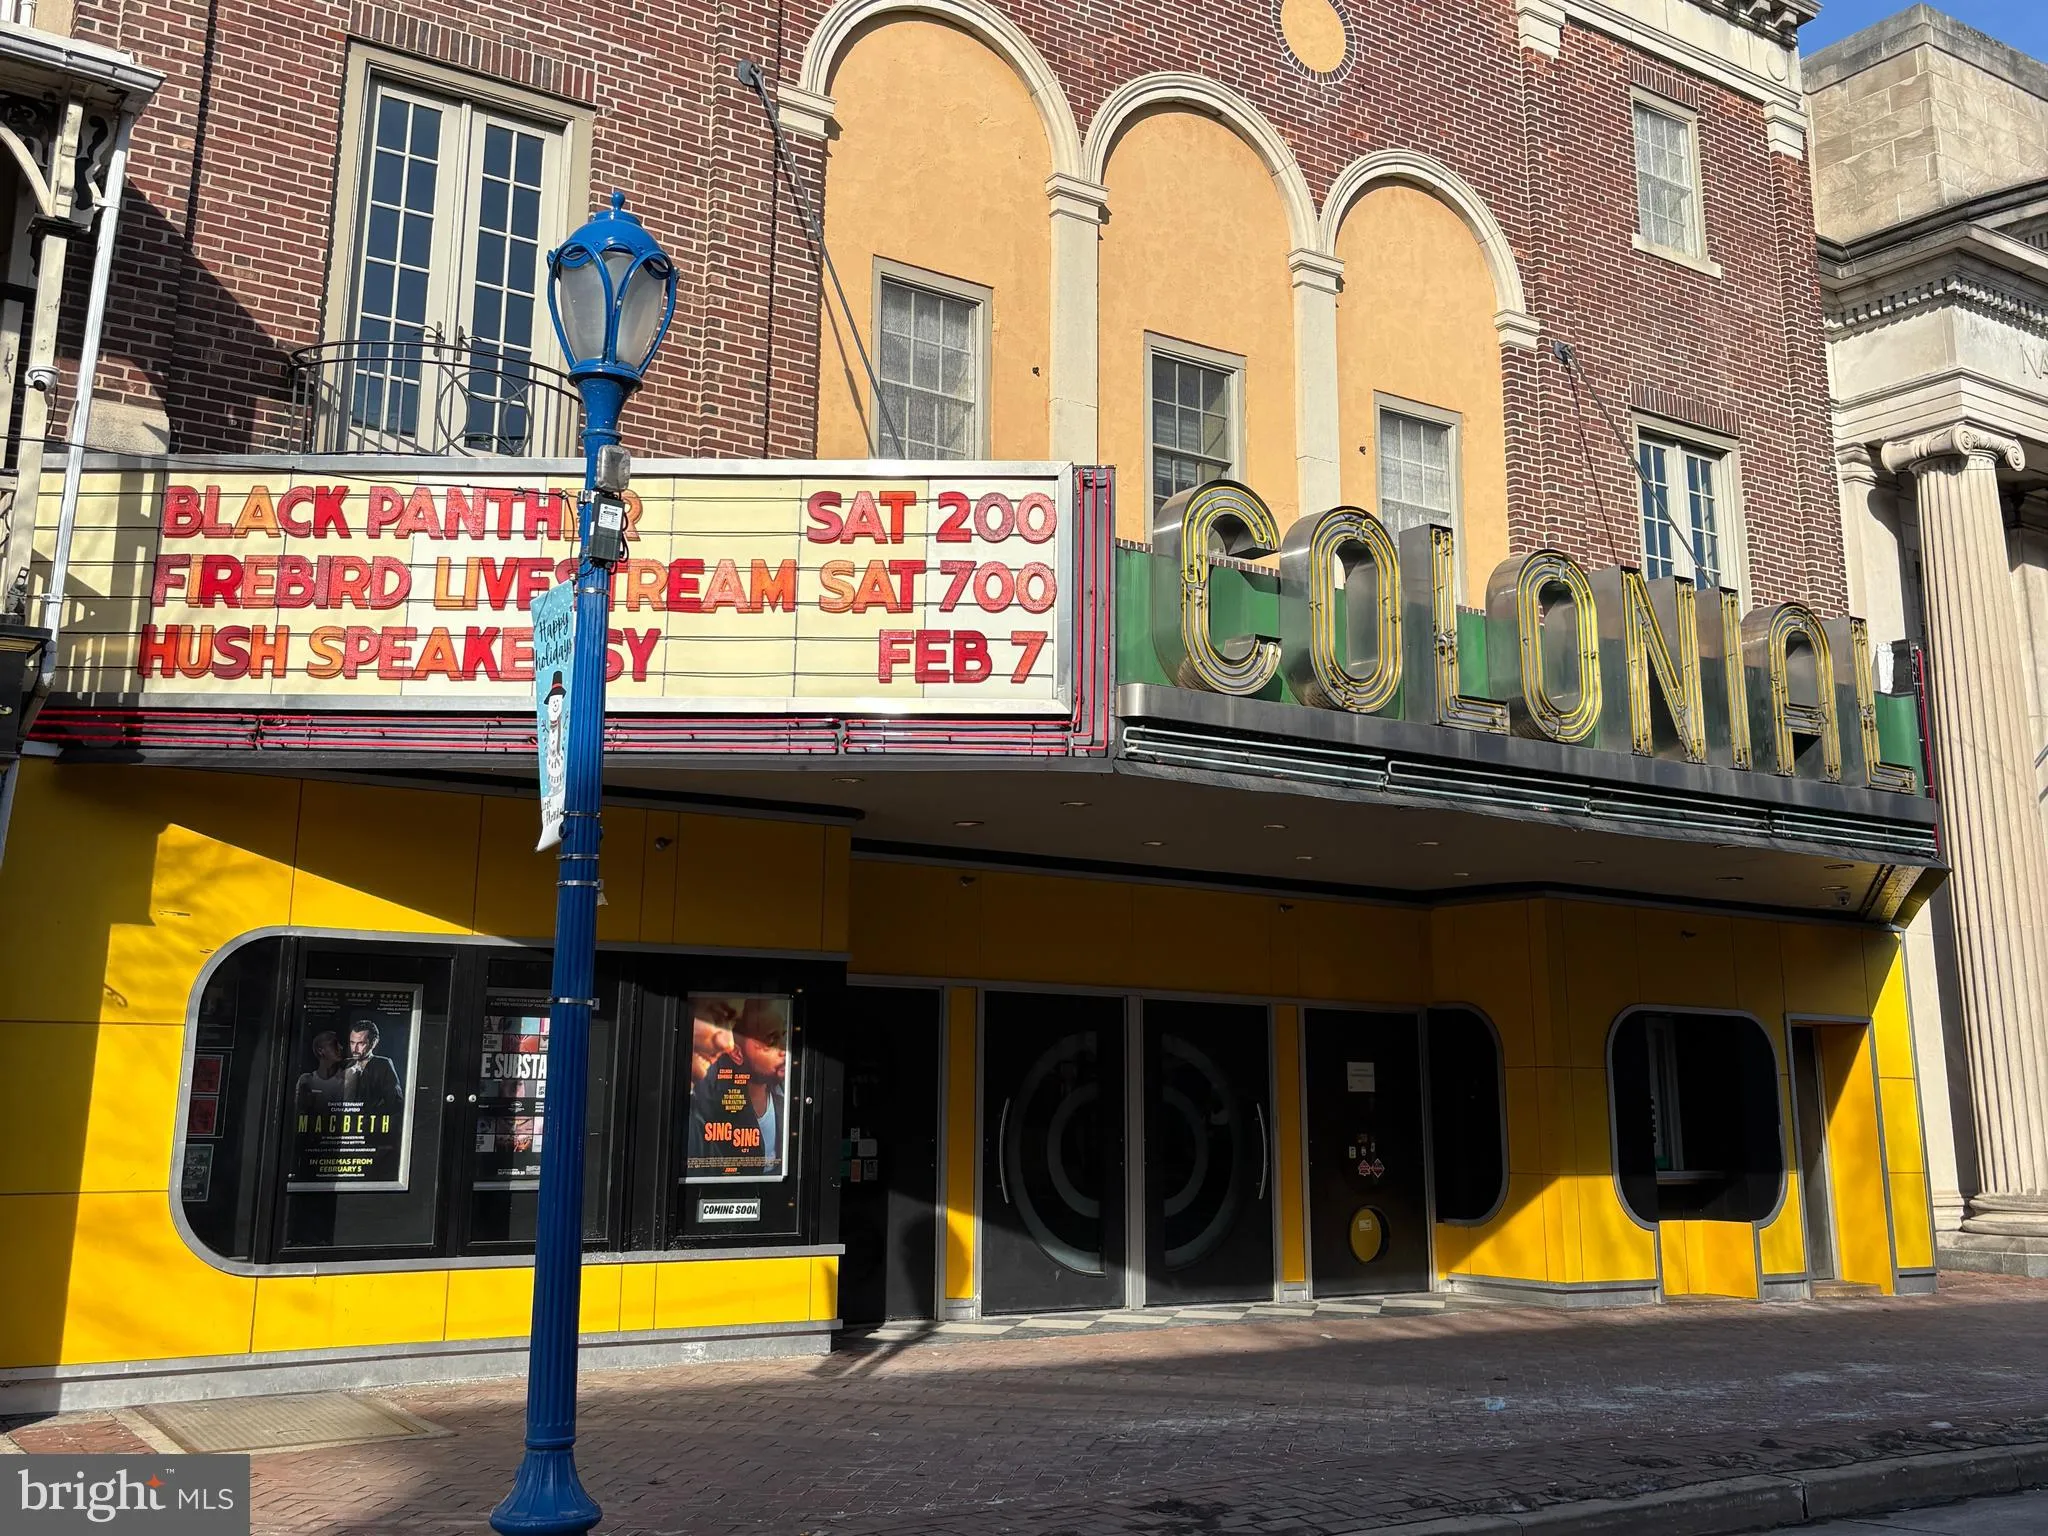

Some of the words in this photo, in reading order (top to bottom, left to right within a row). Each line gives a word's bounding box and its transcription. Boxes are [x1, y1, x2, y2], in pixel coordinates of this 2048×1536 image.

[163, 485, 352, 538] BLACK
[806, 490, 916, 544] SAT
[936, 491, 1057, 544] 200
[151, 554, 412, 610] FIREBIRD
[434, 556, 797, 614] LIVEREAM
[818, 559, 926, 613] SAT
[939, 559, 1057, 614] 700
[539, 612, 568, 642] Happy
[1152, 478, 1917, 798] COLONIAL
[136, 624, 290, 679] HUSH
[306, 625, 662, 683] SPEAKESY
[878, 629, 993, 683] FEB
[1010, 630, 1049, 684] 7
[535, 638, 572, 671] holidays
[298, 1114, 390, 1133] MACBETH
[704, 1122, 733, 1141] SING
[732, 1128, 760, 1147] SING
[319, 1158, 352, 1166] CINEMAS
[319, 1165, 357, 1173] FEBRUARY
[703, 1205, 735, 1215] COMING
